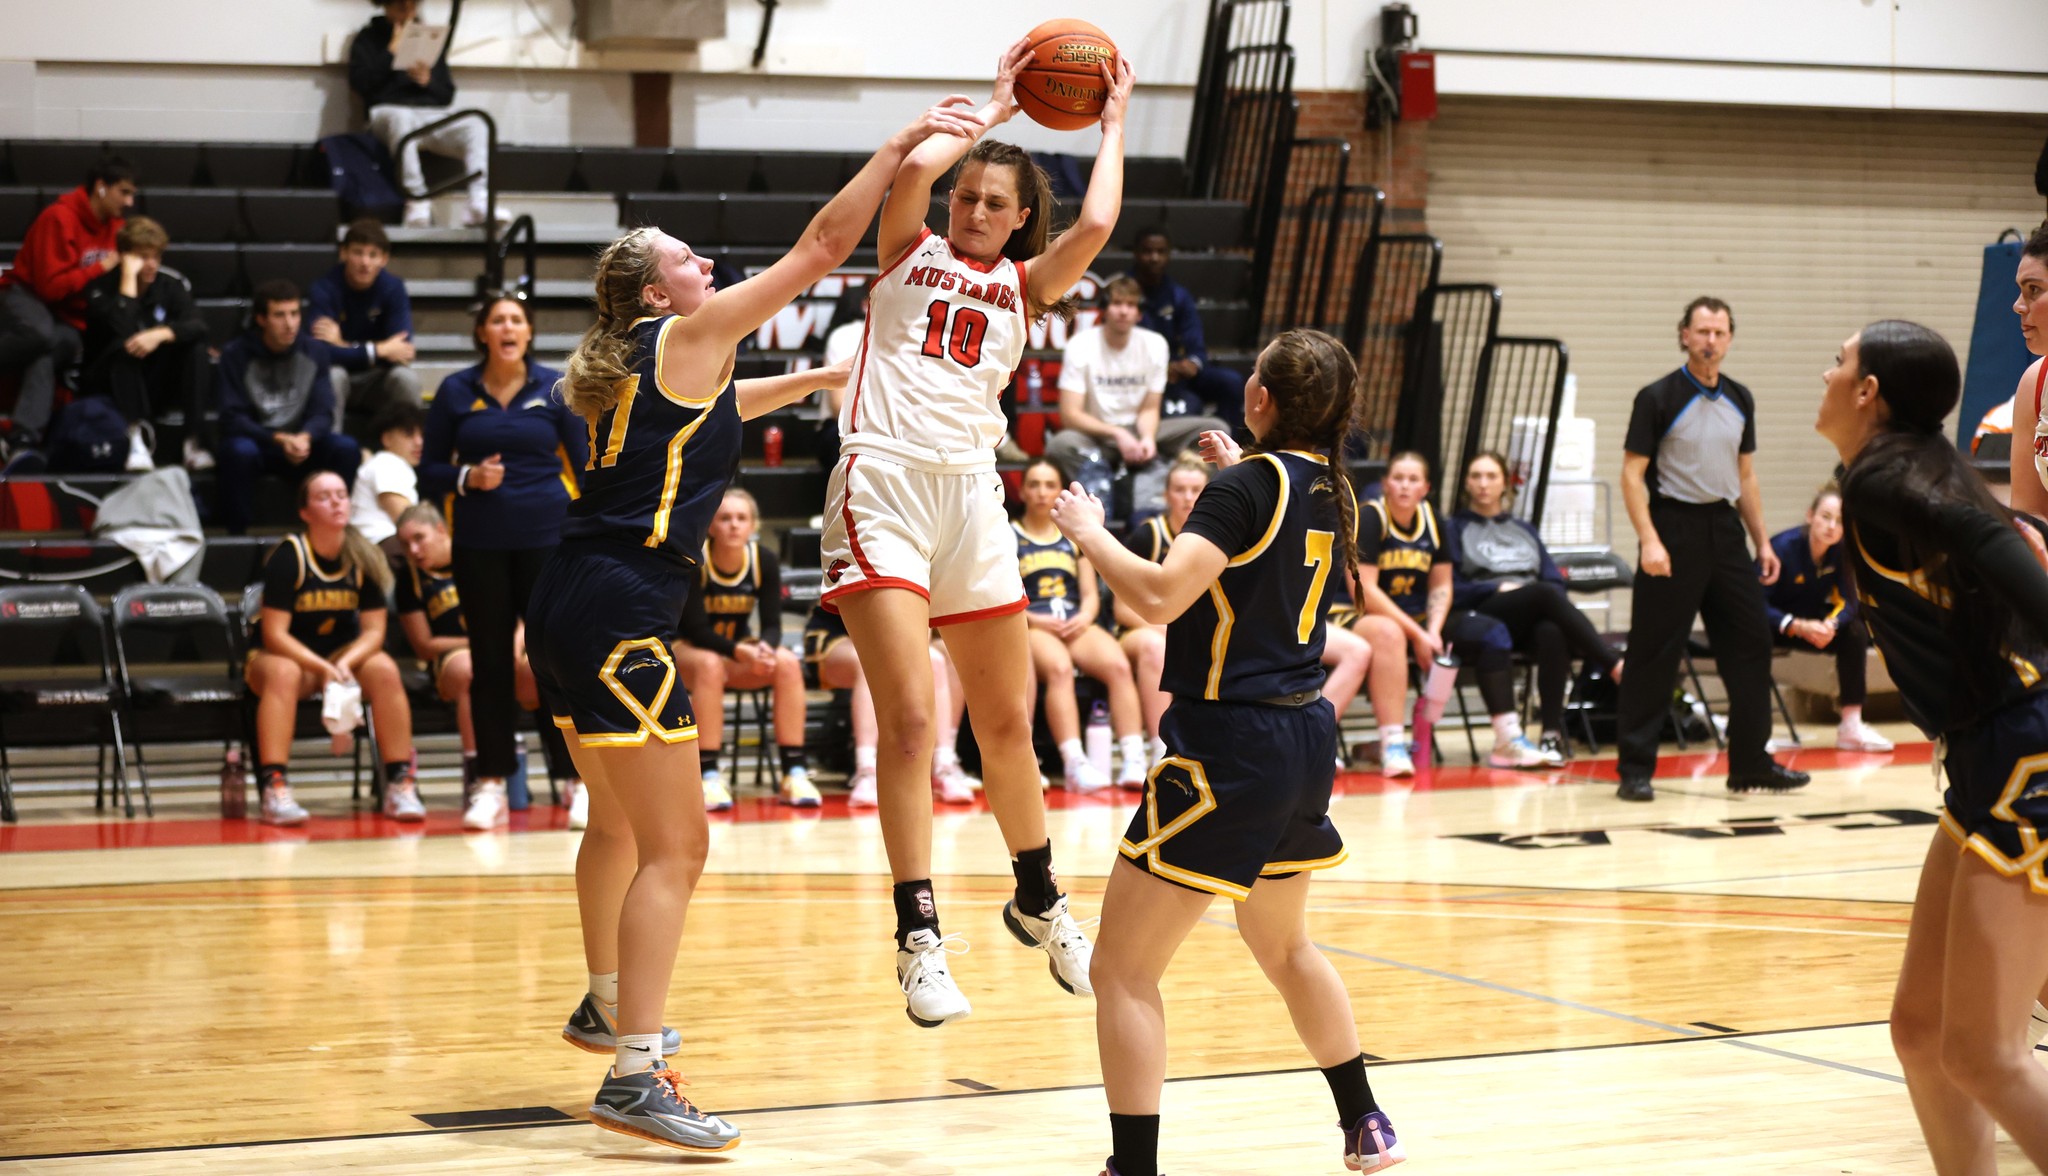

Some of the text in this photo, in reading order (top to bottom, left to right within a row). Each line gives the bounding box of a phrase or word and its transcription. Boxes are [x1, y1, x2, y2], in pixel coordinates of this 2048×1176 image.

[1052, 51, 1114, 69] LEGACY
[1044, 76, 1107, 101] PALDING
[904, 265, 1018, 314] MUSTANGS
[921, 299, 989, 369] 10
[1297, 528, 1336, 645] 7
